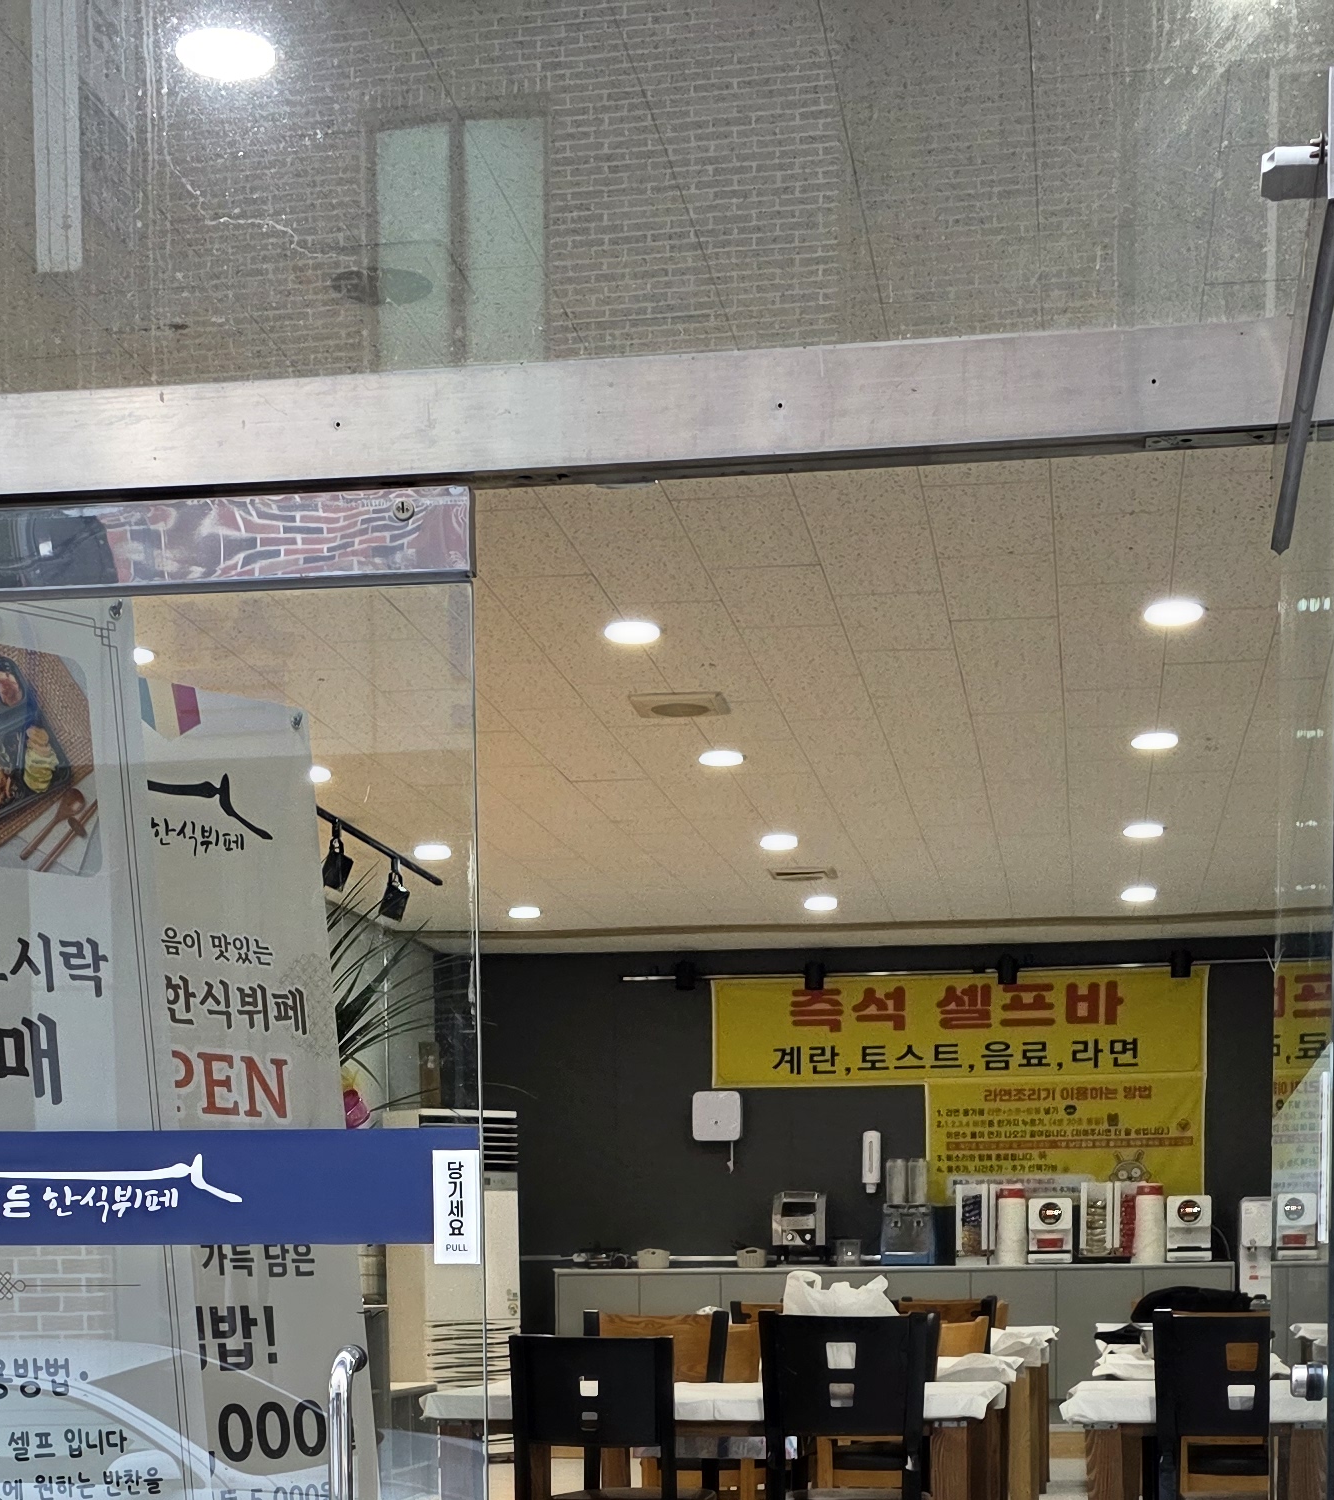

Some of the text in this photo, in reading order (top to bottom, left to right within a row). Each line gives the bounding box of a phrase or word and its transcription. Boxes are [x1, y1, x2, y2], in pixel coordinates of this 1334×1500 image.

[150, 816, 246, 857] 한식뷔페
[209, 932, 274, 966] 맛있는
[165, 973, 308, 1036] 한식뷔페
[789, 979, 1125, 1033] 즉석 셀프바
[984, 1084, 1153, 1103] 라면조리기 이용하는 방법
[42, 1184, 179, 1223] 한식뷔페
[447, 1161, 465, 1236] 당기세요
[201, 1244, 315, 1278] 가득 담은
[446, 1243, 468, 1252] PULL
[7, 1430, 57, 1463] 셀프
[64, 1428, 128, 1460] 입니다
[103, 1466, 164, 1496] 반찬을
